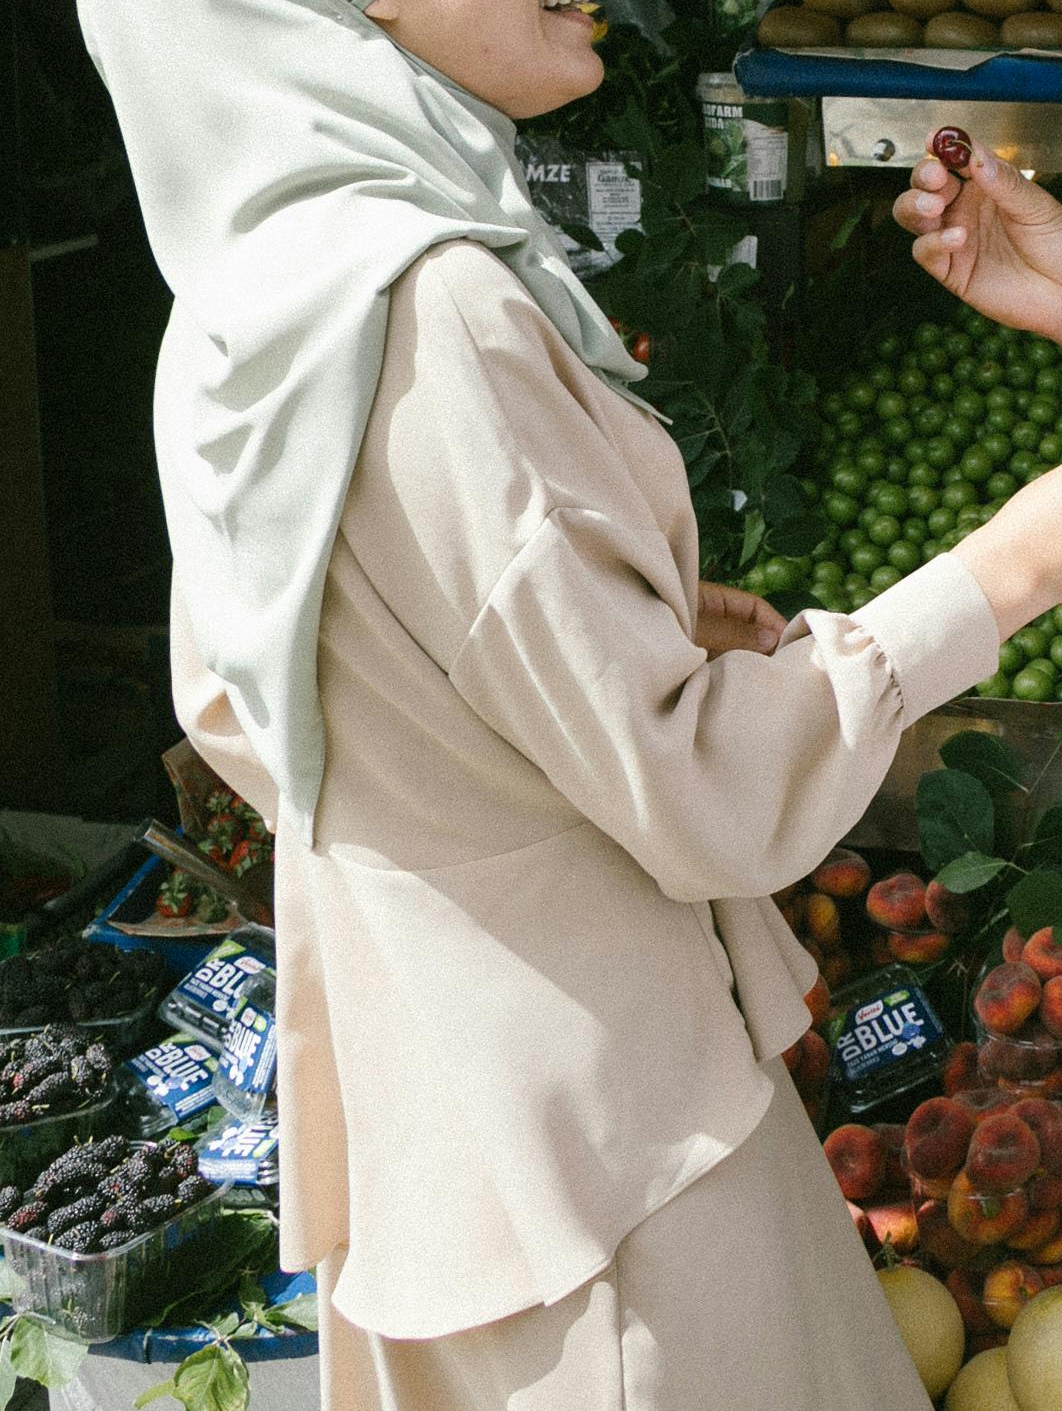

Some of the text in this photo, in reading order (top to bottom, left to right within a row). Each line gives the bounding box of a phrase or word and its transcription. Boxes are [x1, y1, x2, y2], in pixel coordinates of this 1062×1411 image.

[194, 958, 226, 983] DR
[854, 1002, 925, 1052] BLUE
[836, 1031, 863, 1063] DR
[154, 1048, 209, 1091] BLUE
